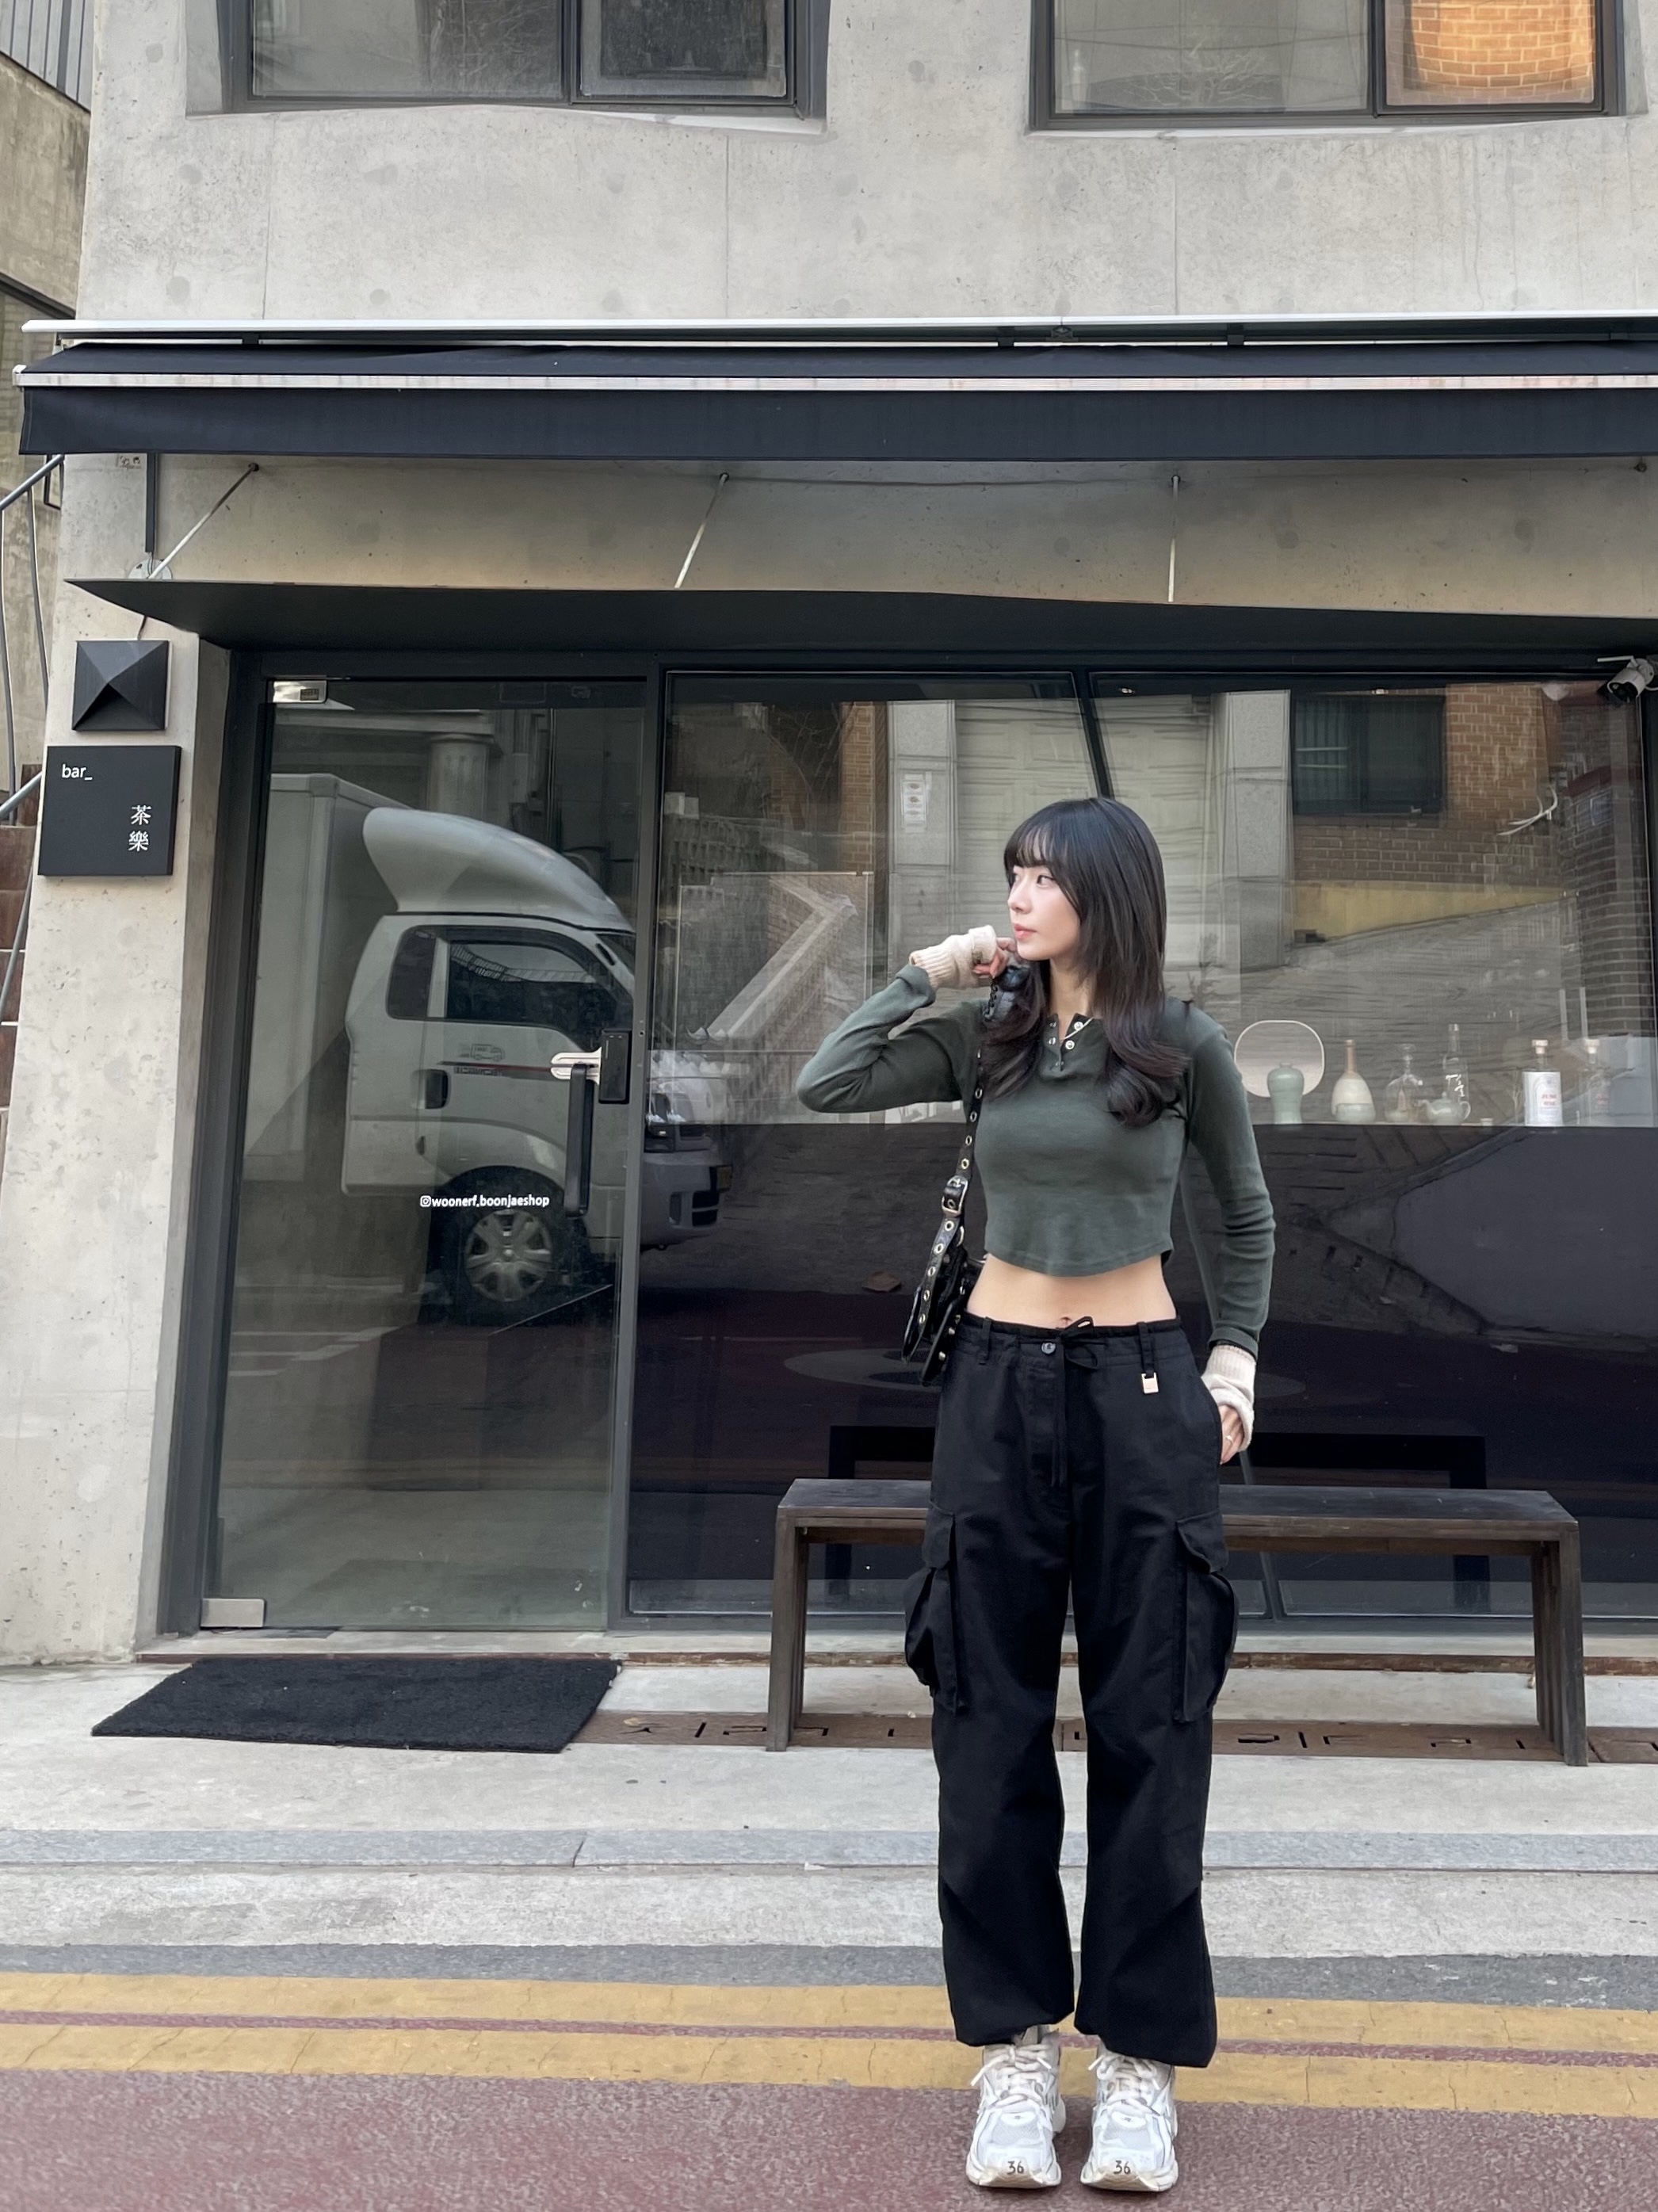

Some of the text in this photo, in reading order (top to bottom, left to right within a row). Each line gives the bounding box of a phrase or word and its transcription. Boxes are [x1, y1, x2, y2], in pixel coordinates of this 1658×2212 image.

[62, 763, 93, 781] bar_
[128, 804, 151, 852] 茶樂
[431, 1194, 550, 1208] woonerf.boonjaeshop
[1007, 2160, 1024, 2175] 36
[1113, 2159, 1131, 2175] 36
